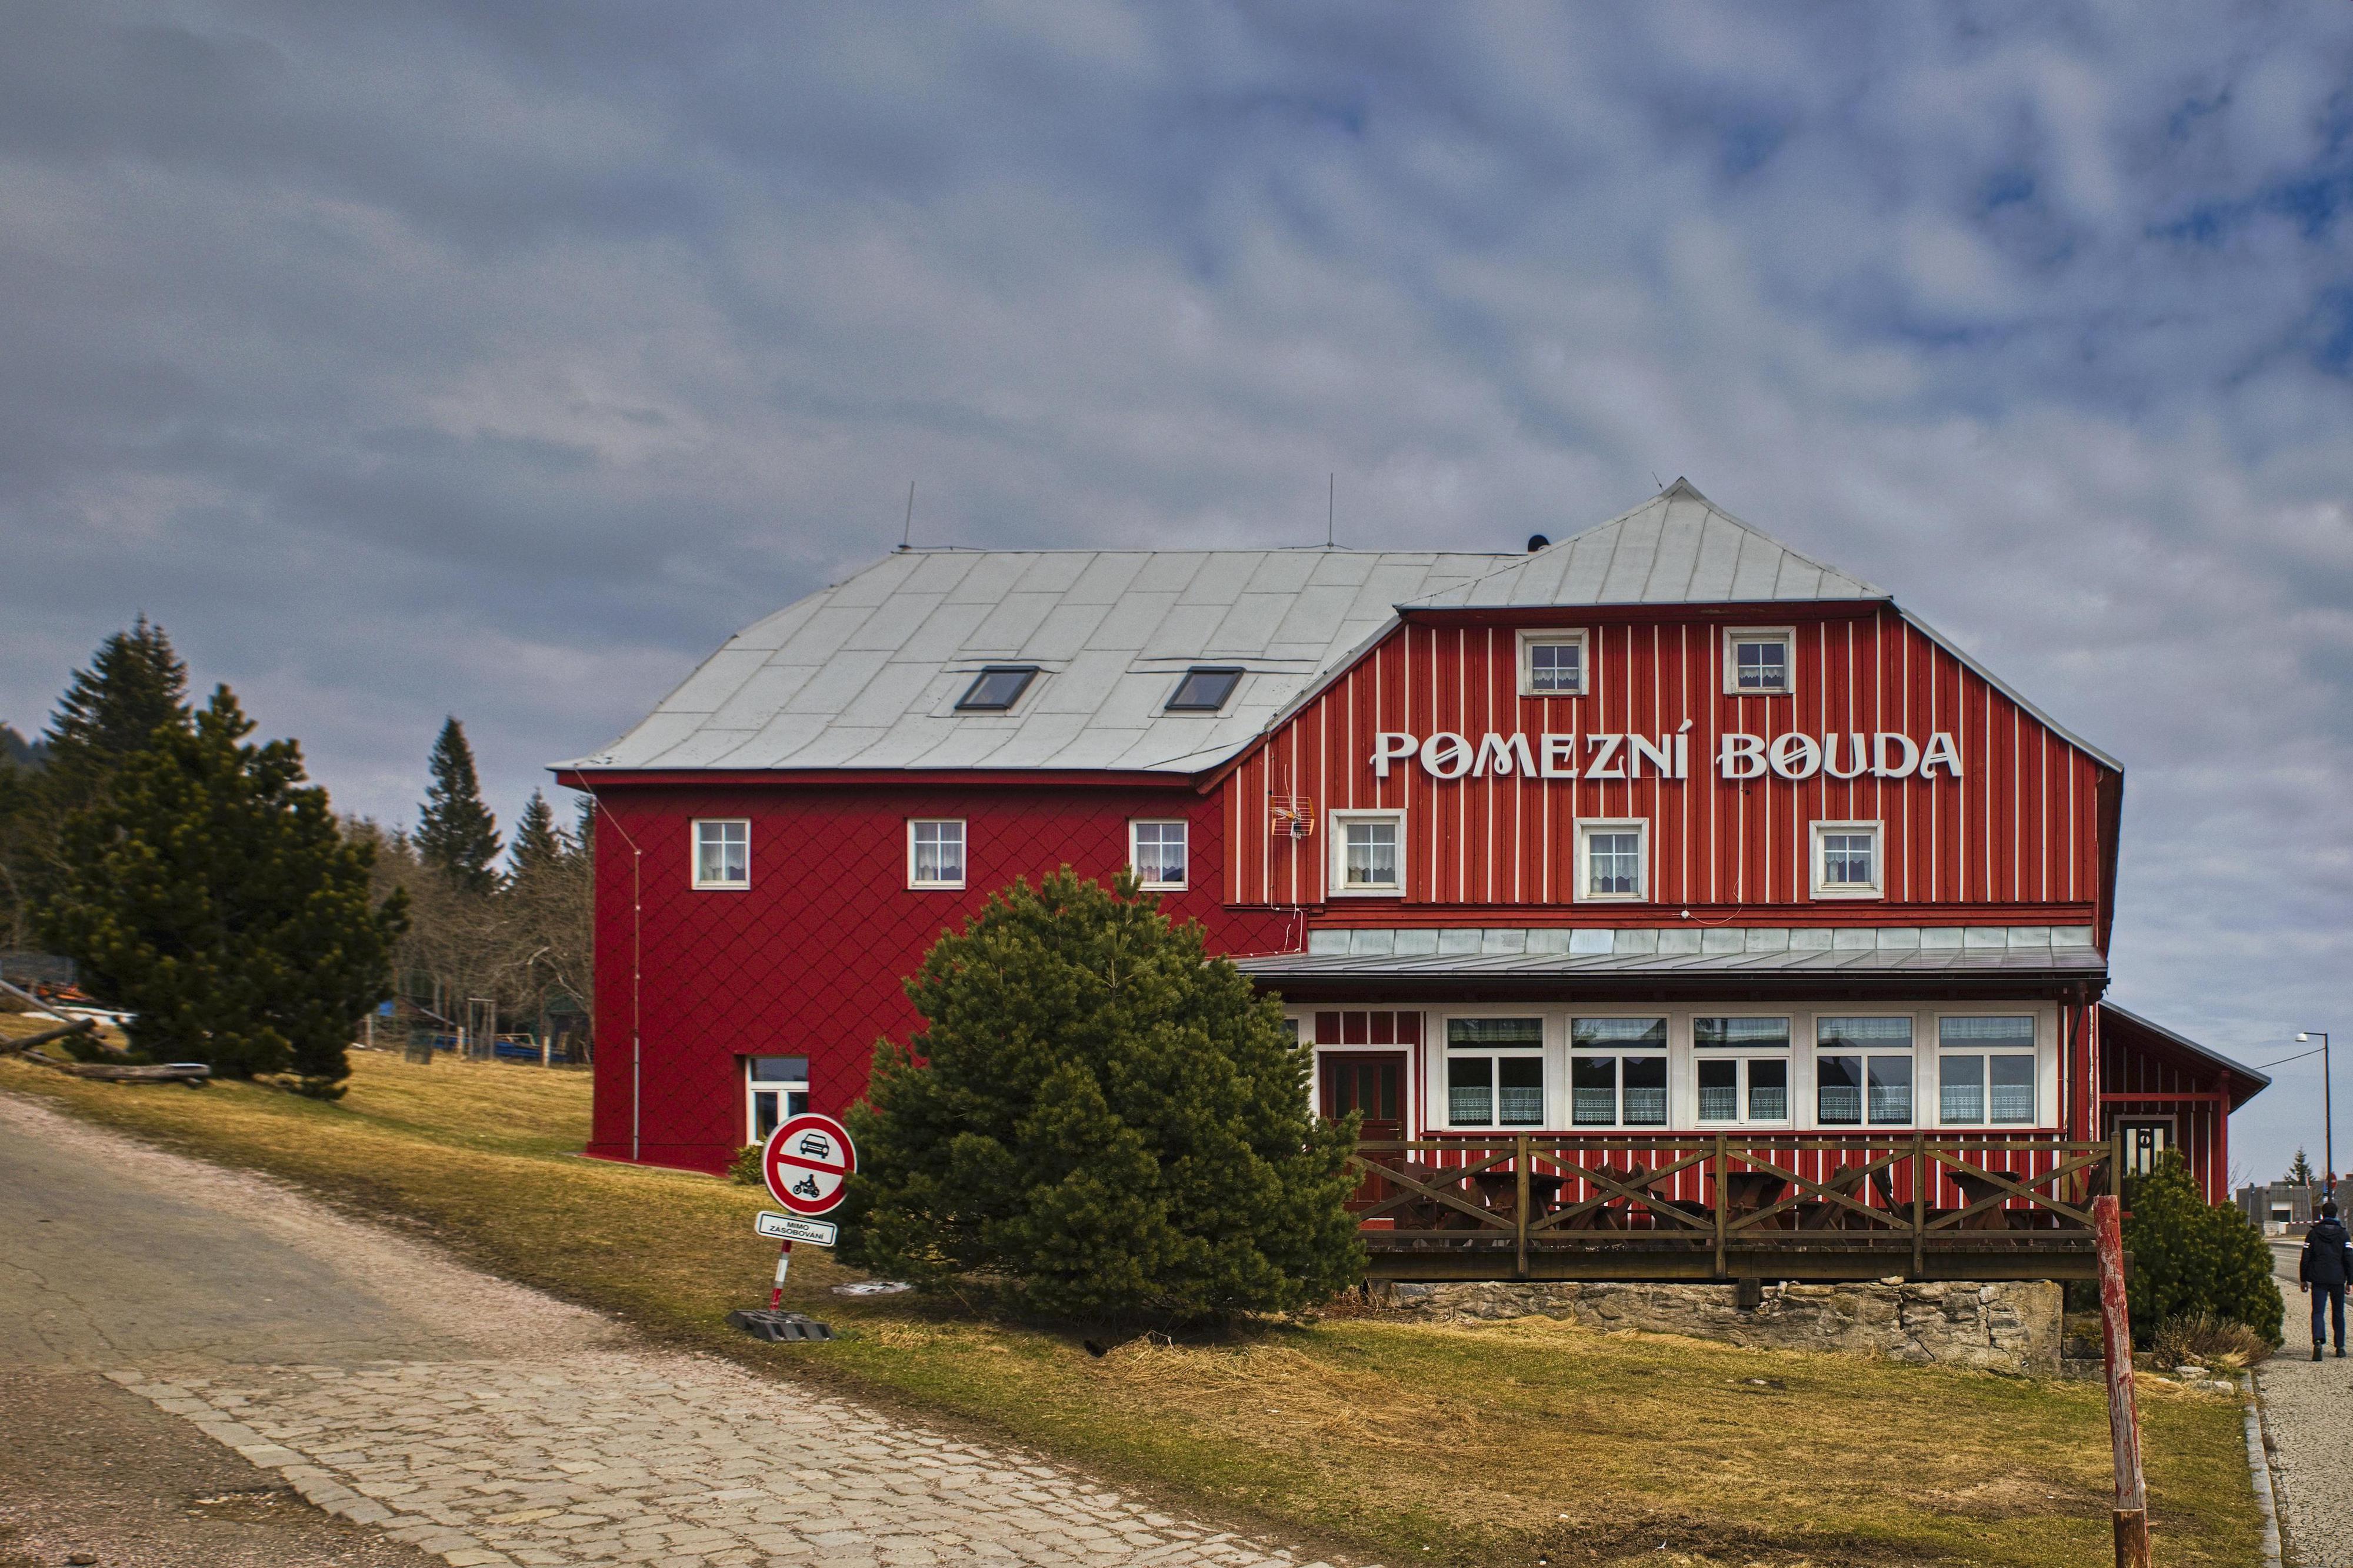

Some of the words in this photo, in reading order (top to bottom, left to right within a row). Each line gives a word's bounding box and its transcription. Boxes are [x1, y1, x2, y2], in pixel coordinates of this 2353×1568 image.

[1369, 719, 1693, 779] POMEZNÍ
[1716, 732, 1964, 779] BOUDA
[787, 1222, 809, 1230] MIMO
